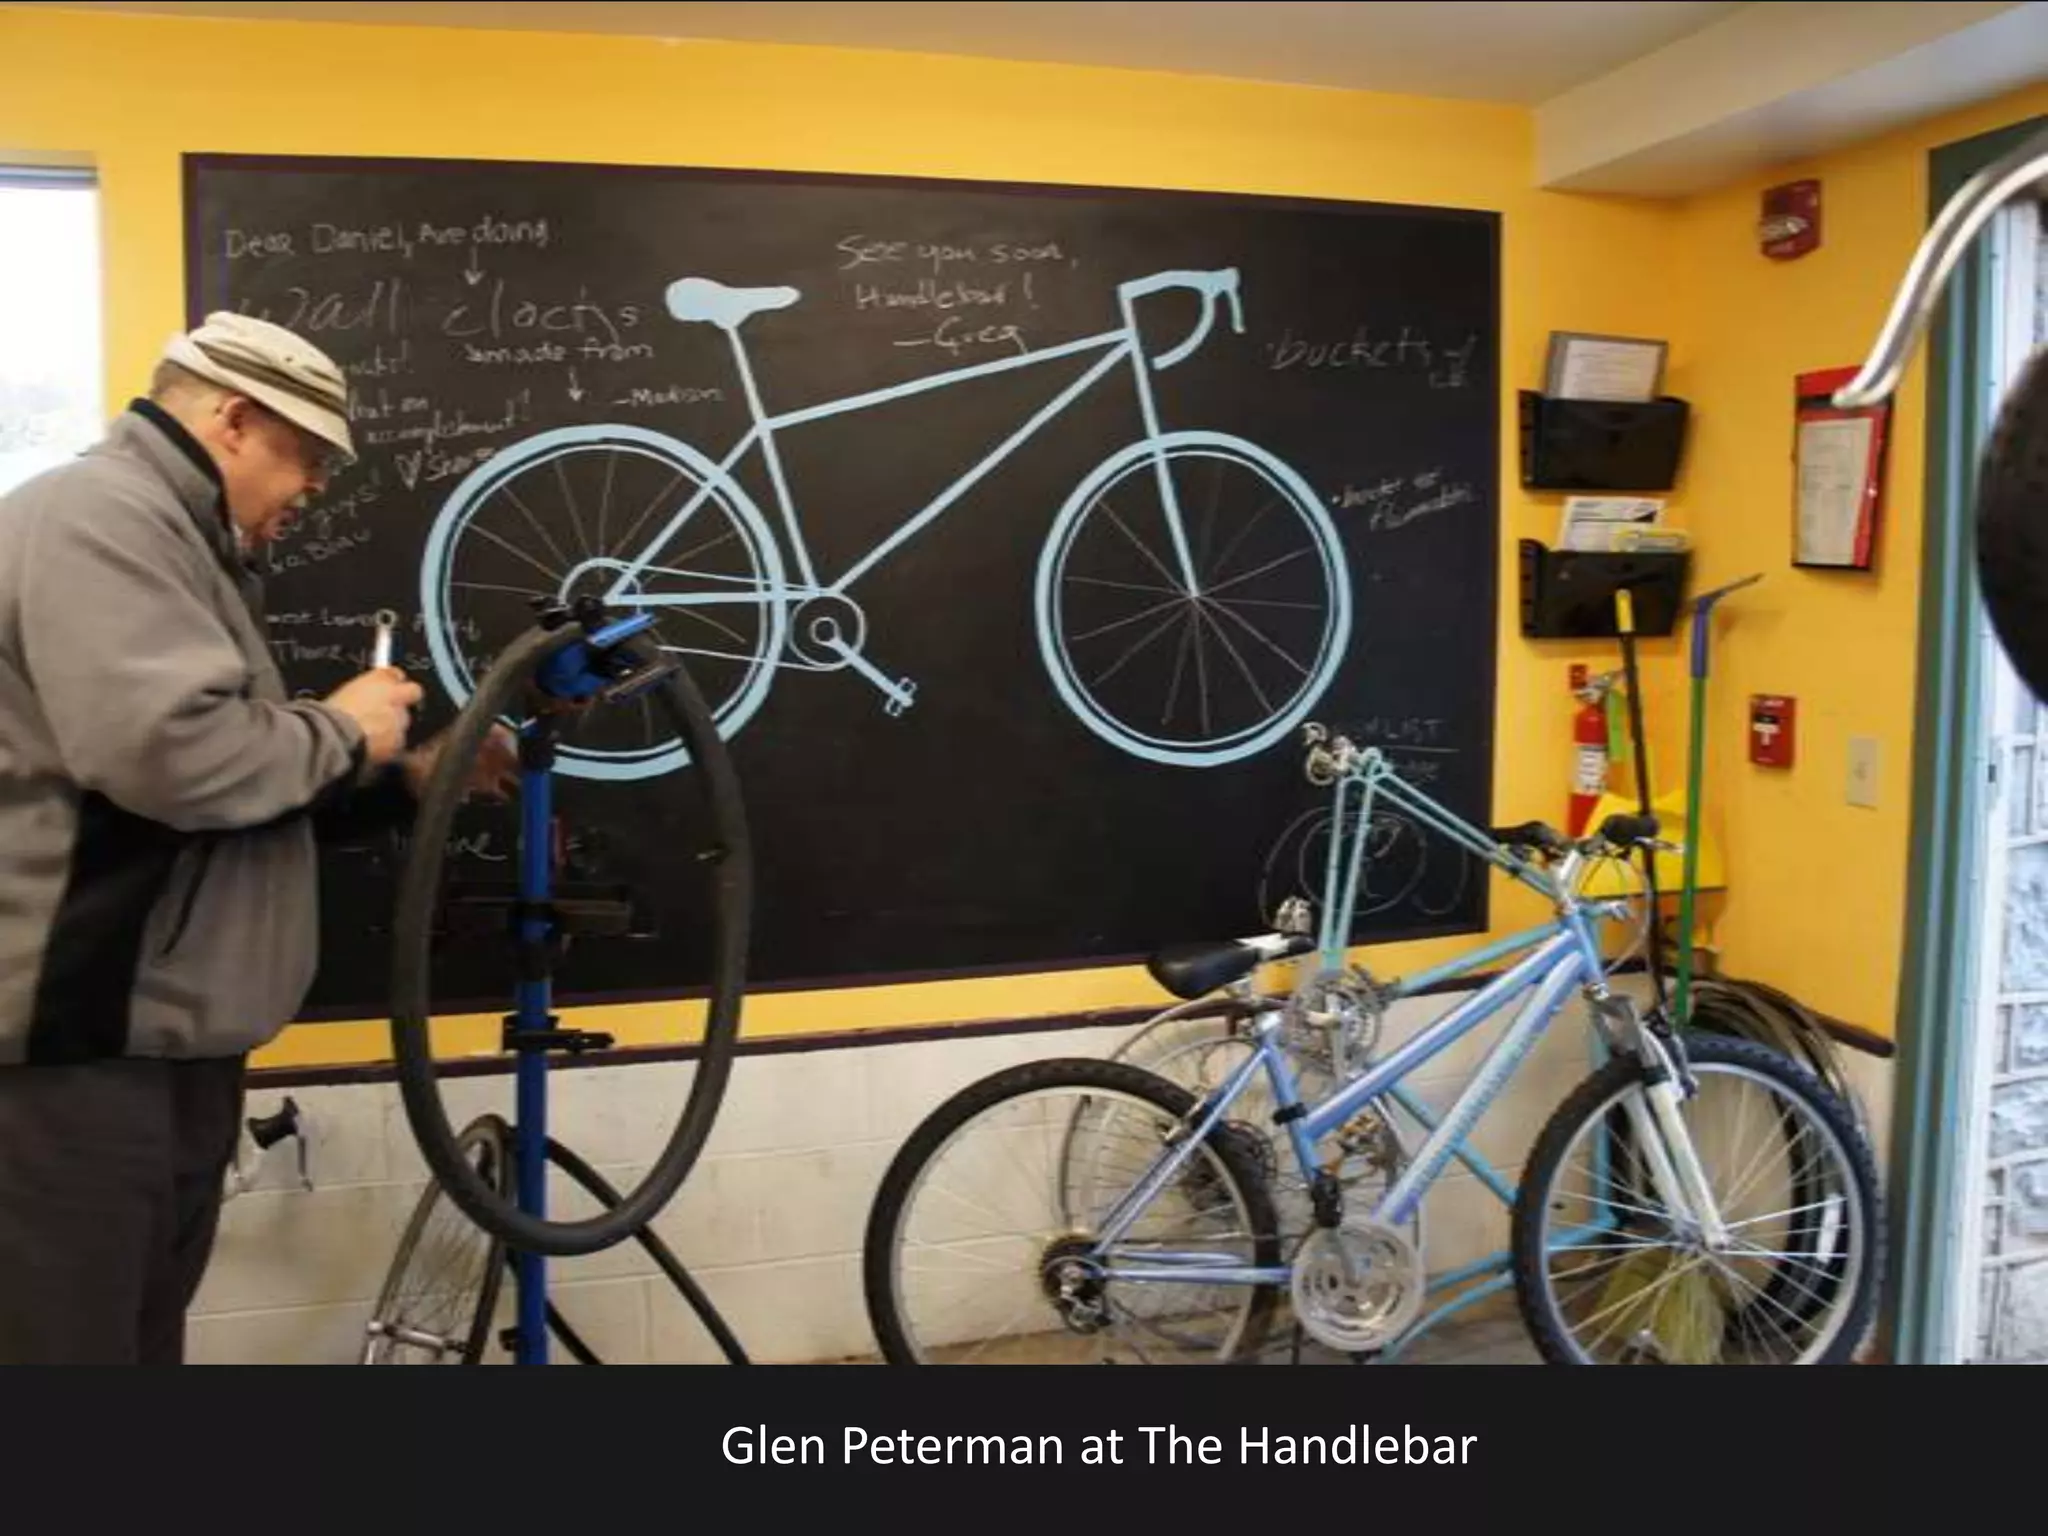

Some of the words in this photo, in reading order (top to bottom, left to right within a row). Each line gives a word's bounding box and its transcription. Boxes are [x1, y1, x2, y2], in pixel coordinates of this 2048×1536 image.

[226, 229, 295, 258] Dear
[836, 234, 907, 270] See
[918, 244, 976, 276] you
